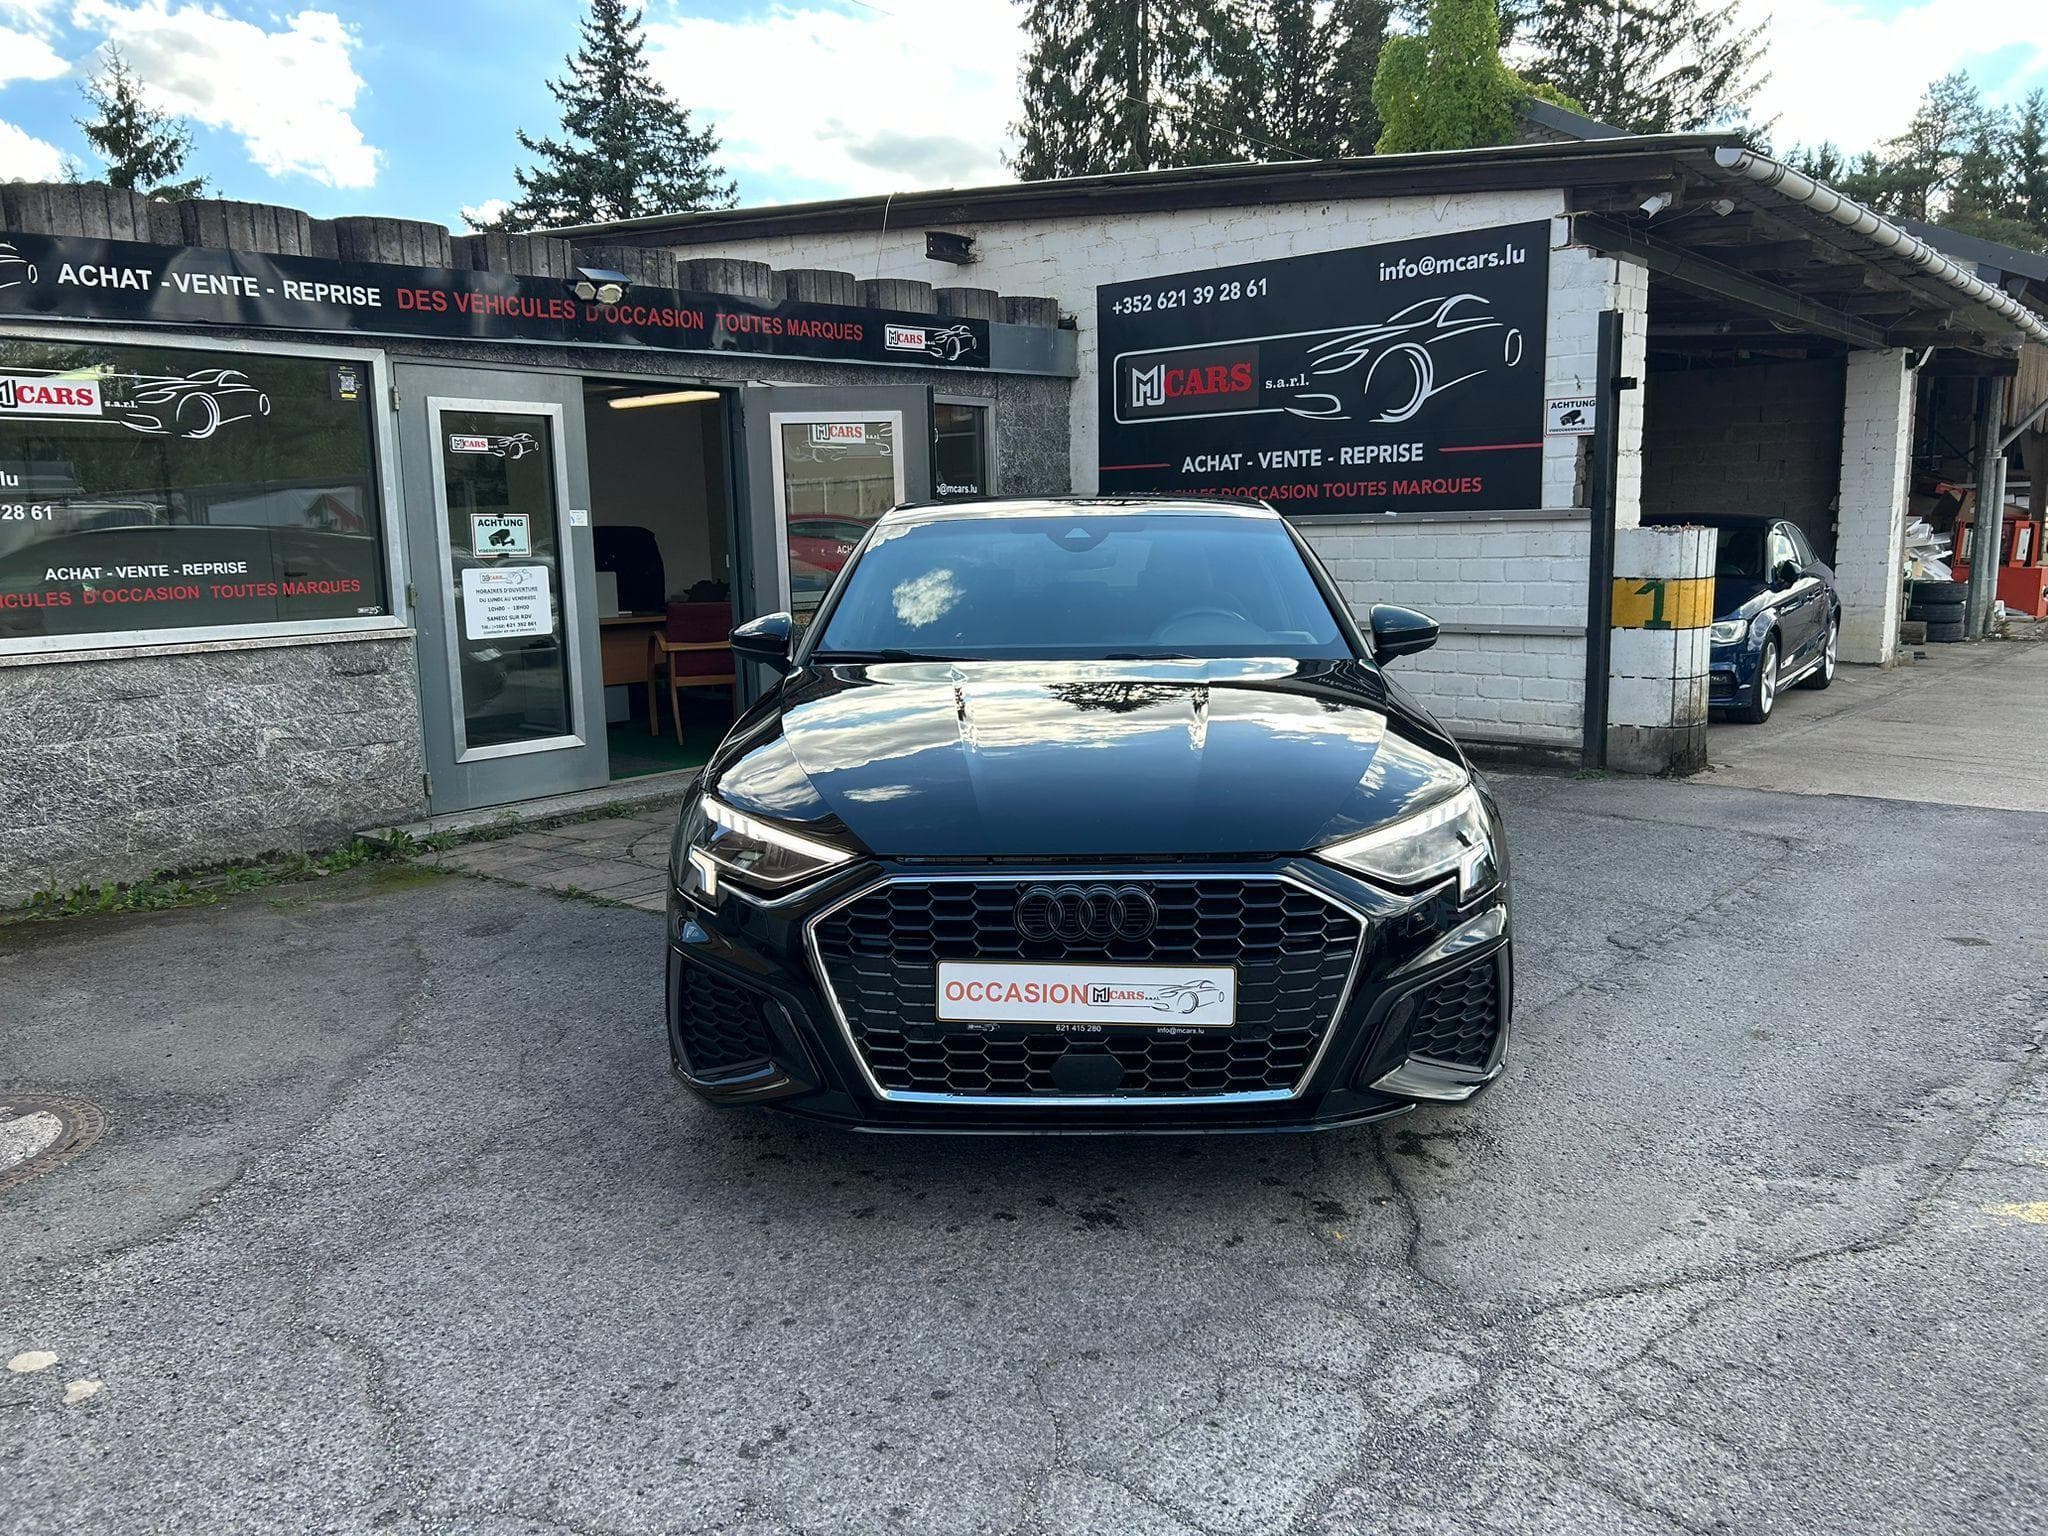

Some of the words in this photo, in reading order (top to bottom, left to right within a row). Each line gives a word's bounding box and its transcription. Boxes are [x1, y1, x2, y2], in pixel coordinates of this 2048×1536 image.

[1379, 243, 1526, 282] info@mcars.lu
[57, 263, 152, 290] ACHAT
[283, 279, 382, 307] REPRISE
[397, 288, 448, 312] DES
[453, 288, 576, 320] VÉHICULES
[586, 304, 704, 330] D'OCCASION
[716, 313, 783, 335] TOUTES
[787, 319, 863, 341] MARQUES
[1112, 294, 1152, 315] +352
[1157, 289, 1186, 310] 621
[1193, 285, 1214, 305] 39
[1219, 282, 1241, 301] 28
[1246, 278, 1267, 298] 61
[1265, 373, 1310, 389] s.a.r.l.
[1551, 400, 1596, 409] ACHTUNG
[1181, 453, 1242, 473] ACHAT
[1258, 448, 1322, 469] VENTE
[1340, 443, 1424, 465] REPRISE
[1323, 480, 1387, 498] TOUTES
[1392, 477, 1483, 495] MARQUES
[1, 504, 25, 520] 28
[31, 505, 52, 520] 61
[478, 519, 524, 527] ACHTUNG
[45, 567, 102, 581] ACHAT
[115, 565, 170, 579] VENTE
[182, 561, 248, 576] REPRISE
[83, 585, 200, 605] D'OCCASION
[210, 582, 278, 599] TOUTES
[282, 579, 361, 595] MARQUES
[1634, 582, 1671, 628] 1
[945, 981, 1088, 1005] OCCASION
[1055, 1024, 1070, 1032] 621
[1071, 1024, 1086, 1032] 415
